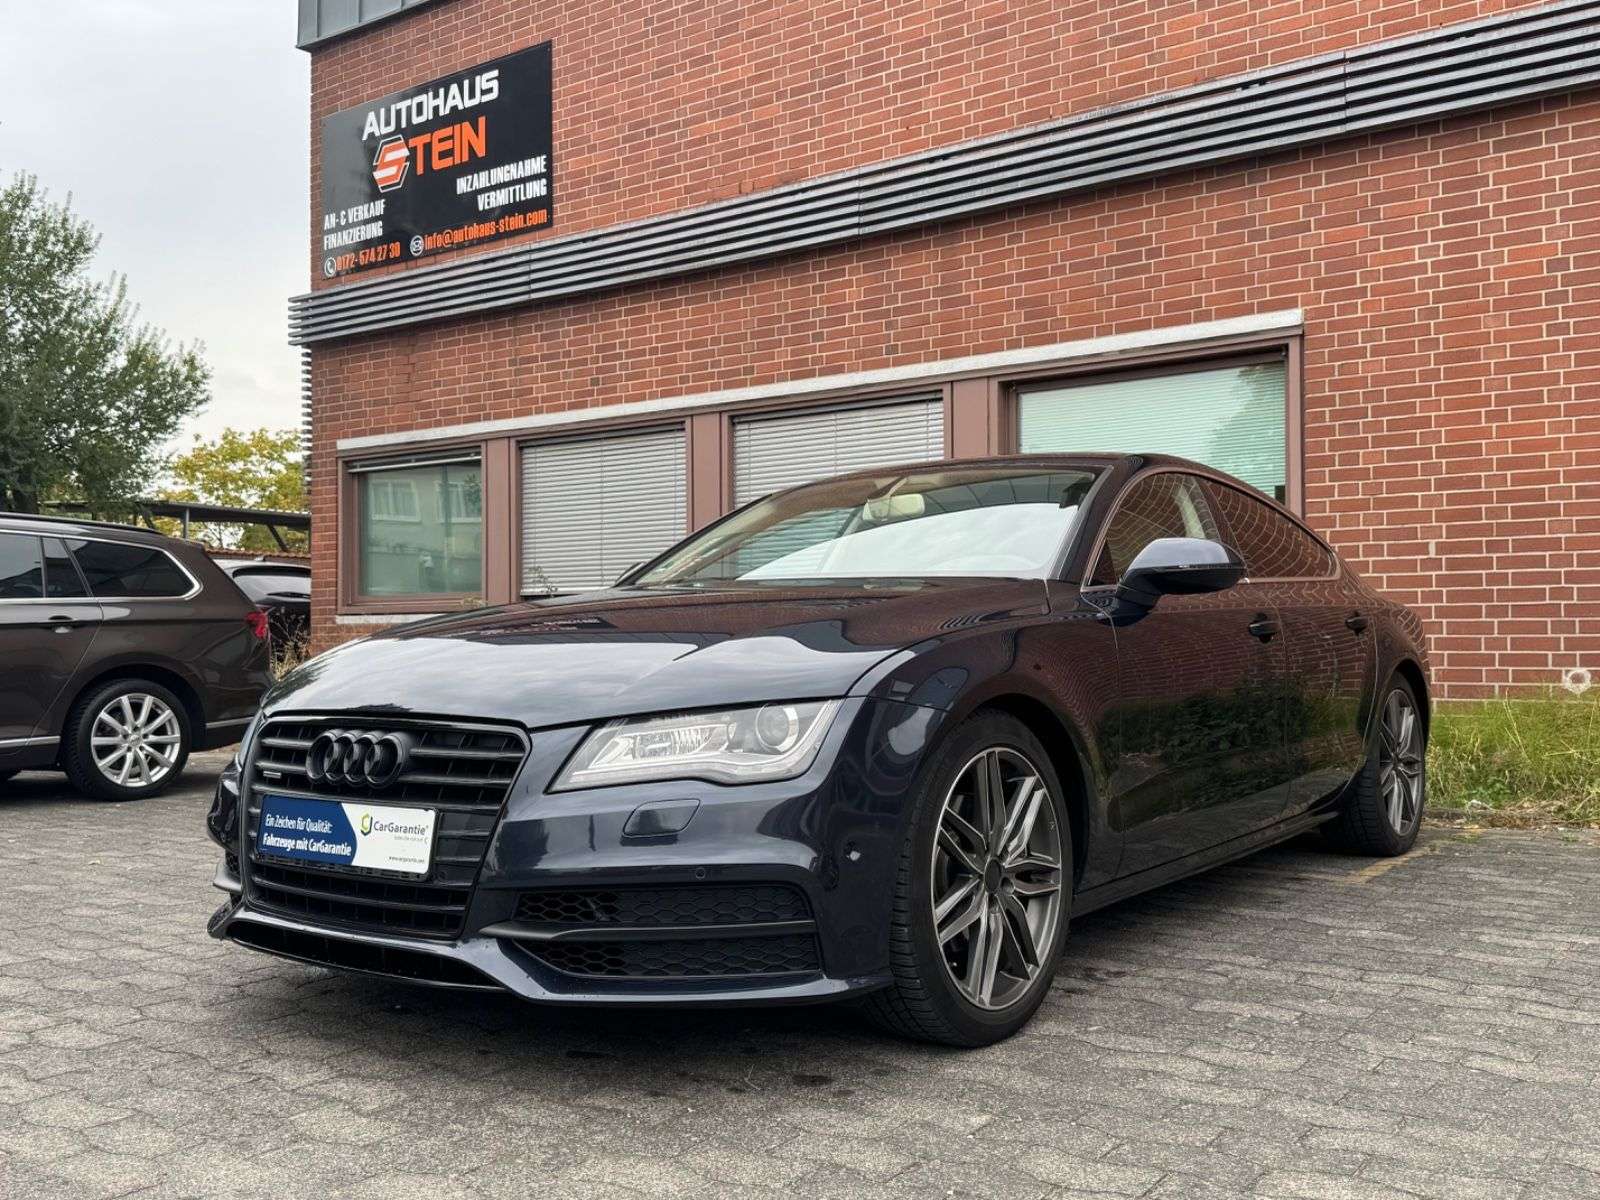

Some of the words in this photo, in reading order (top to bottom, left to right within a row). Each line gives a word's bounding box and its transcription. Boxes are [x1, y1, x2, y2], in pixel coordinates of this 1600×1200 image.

[361, 69, 500, 141] AUTOHAUS
[372, 115, 487, 191] STEIN
[456, 155, 547, 195] INZAHLUNGNAHME
[477, 178, 548, 211] VERMITTLUNG
[347, 199, 386, 224] VERKAUF
[324, 221, 383, 250] FINANZIERUNG
[424, 208, 548, 250] info@autohaus-stein.com
[377, 244, 388, 262] 27
[389, 241, 401, 258] 30
[265, 813, 275, 827] Ein
[274, 814, 296, 830] Zeichen
[296, 816, 306, 830] für
[262, 832, 295, 851] Fahrzeuge
[296, 837, 308, 851] mit
[308, 838, 352, 856] CarGarantie
